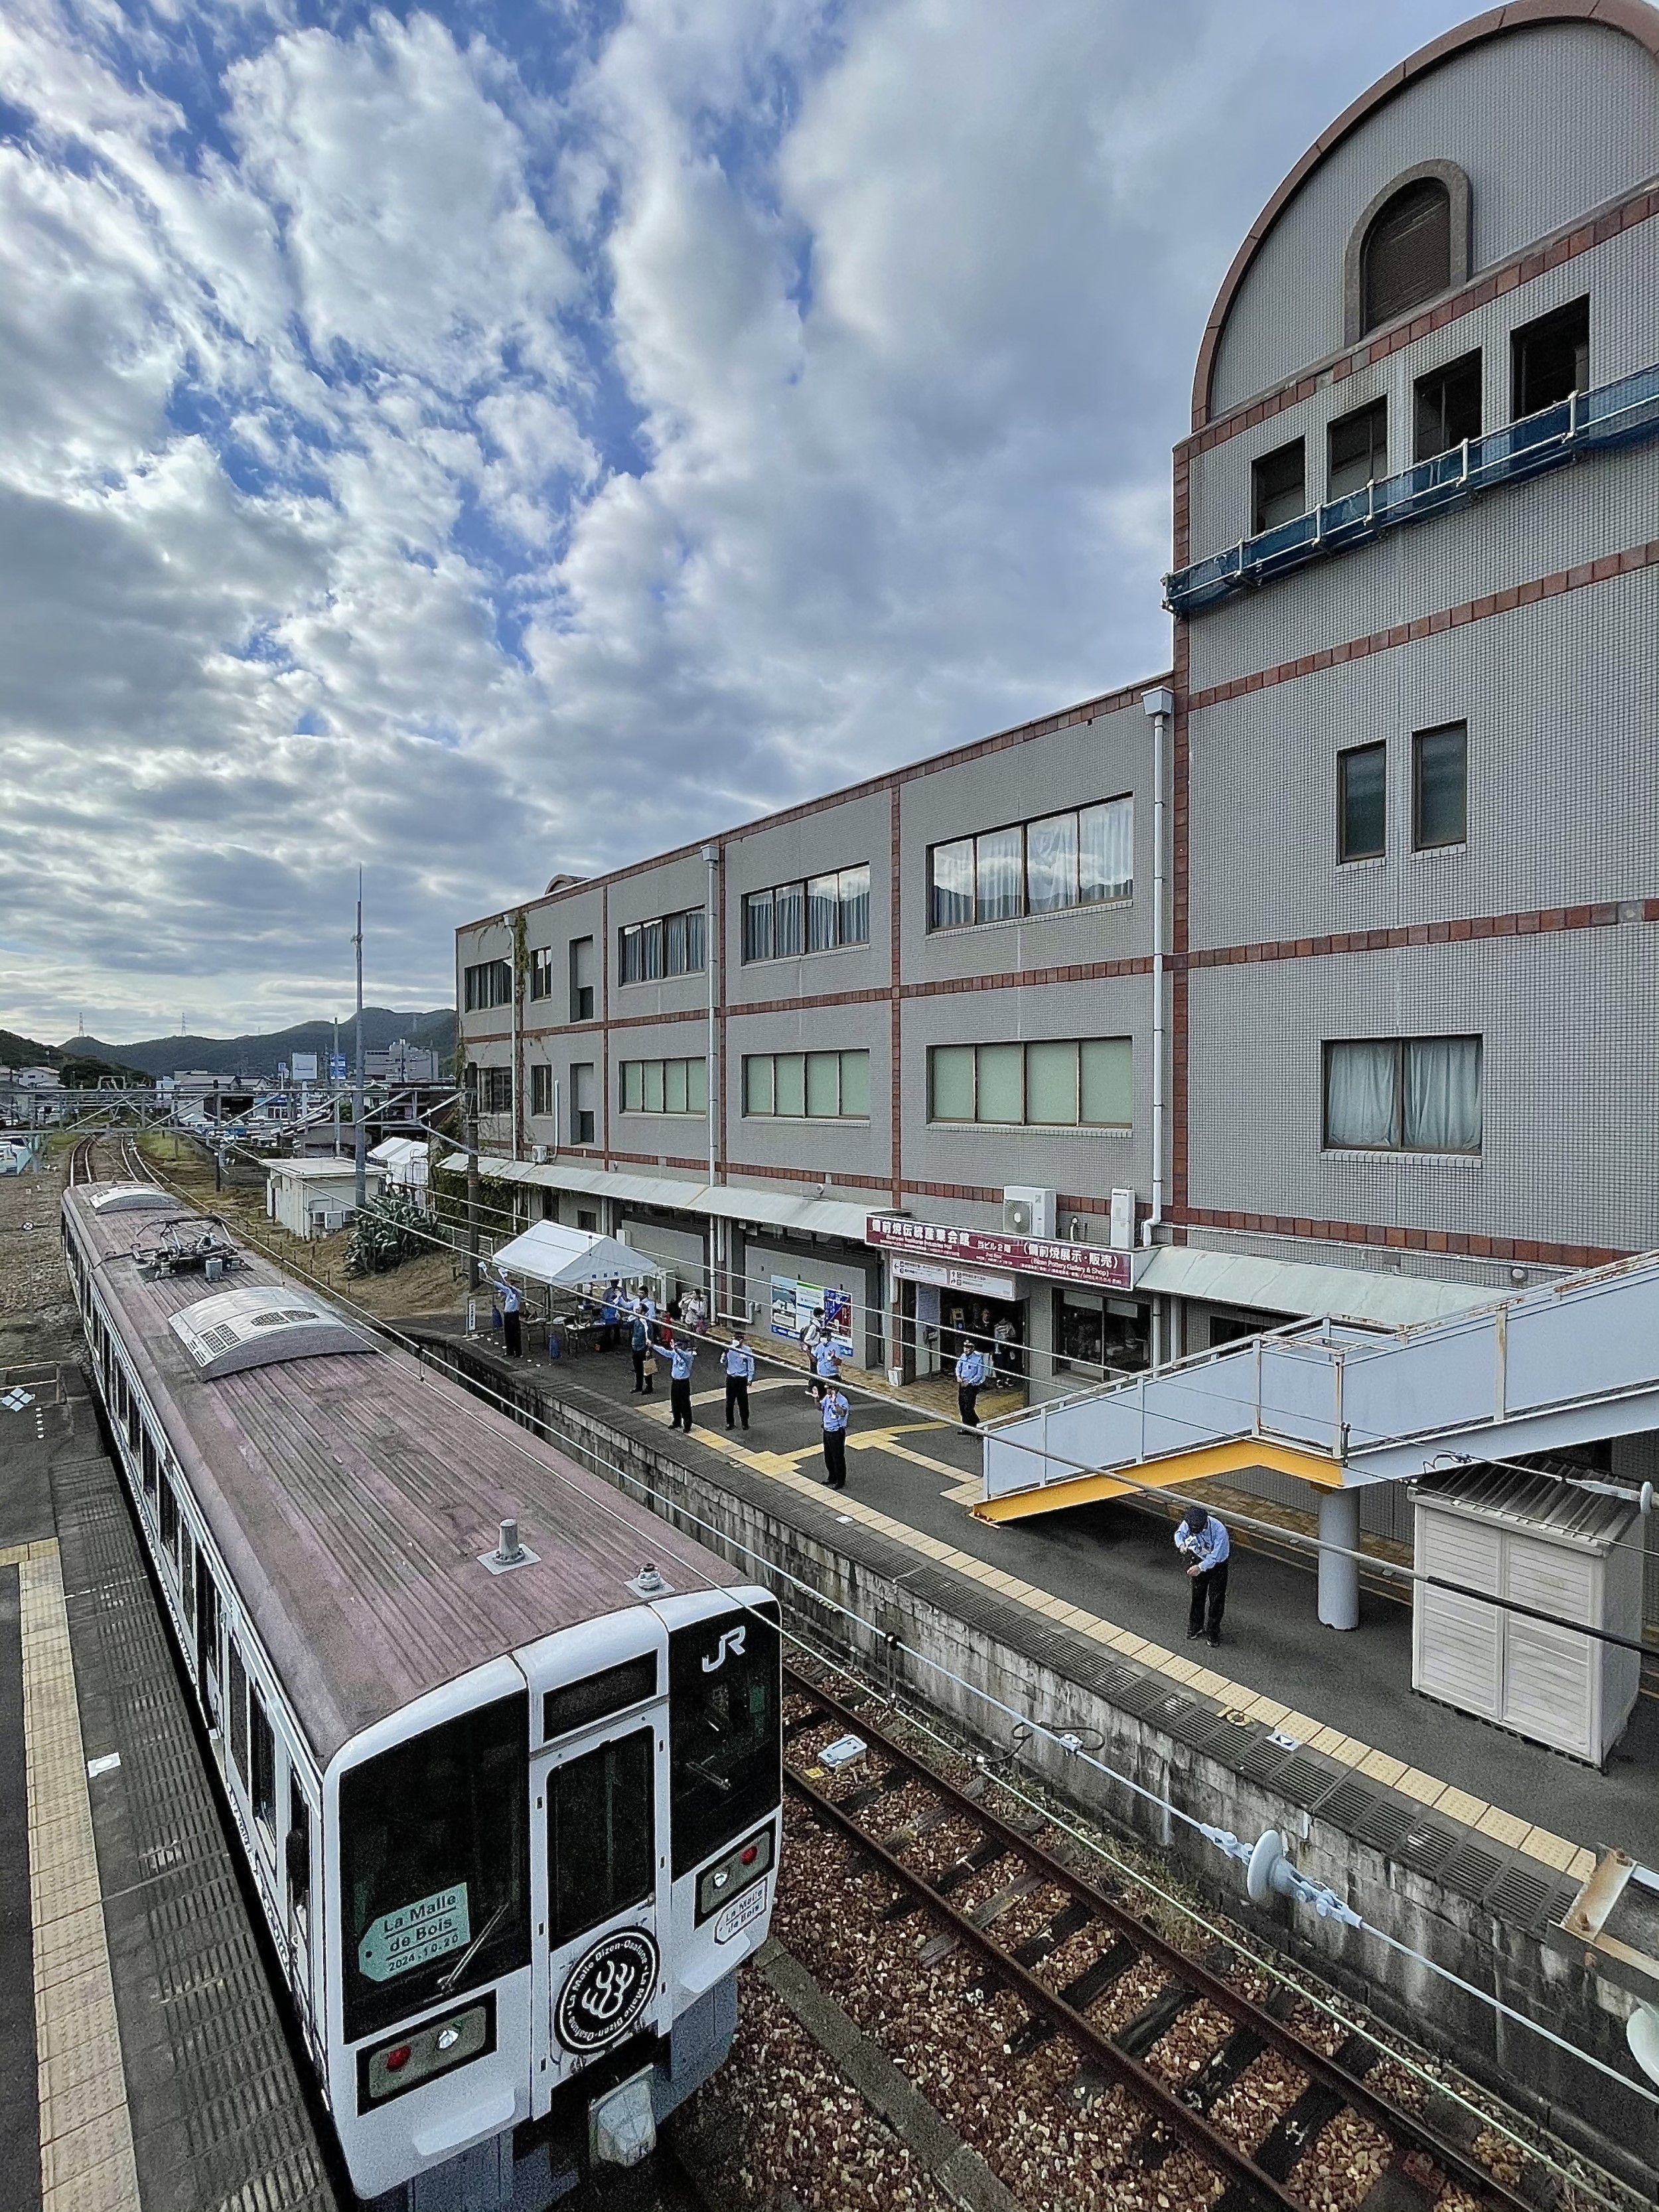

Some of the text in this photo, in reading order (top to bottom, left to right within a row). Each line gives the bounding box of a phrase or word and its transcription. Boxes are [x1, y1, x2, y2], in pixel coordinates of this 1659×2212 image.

[702, 1625, 746, 1672] JR
[384, 1895, 456, 1933] La Malle
[726, 1889, 762, 1923] La Malle
[390, 1918, 452, 1952] de Bois
[389, 1933, 459, 1972] 2024.10.20
[572, 1961, 595, 1991] Malle
[624, 1988, 644, 2018] Malle
